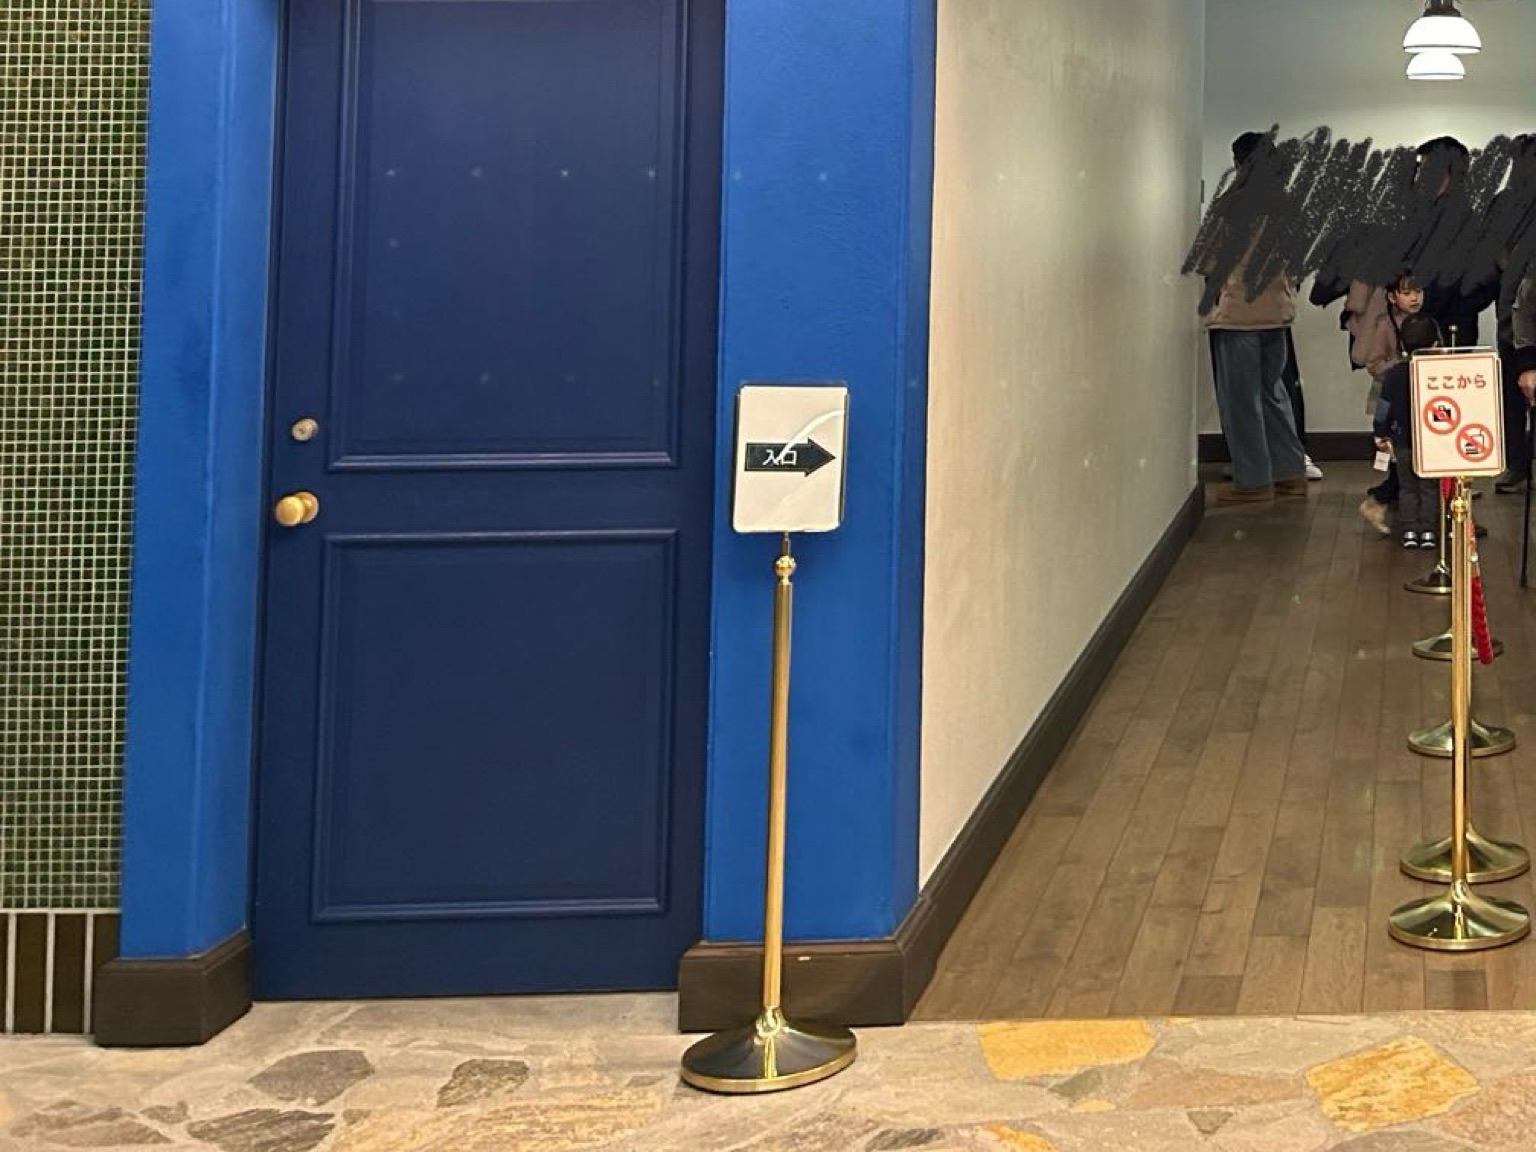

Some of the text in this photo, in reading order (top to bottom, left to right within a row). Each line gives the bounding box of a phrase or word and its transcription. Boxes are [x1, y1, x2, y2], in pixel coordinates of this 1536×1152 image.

[1427, 374, 1487, 390] ここから
[762, 449, 798, 465] 入口
